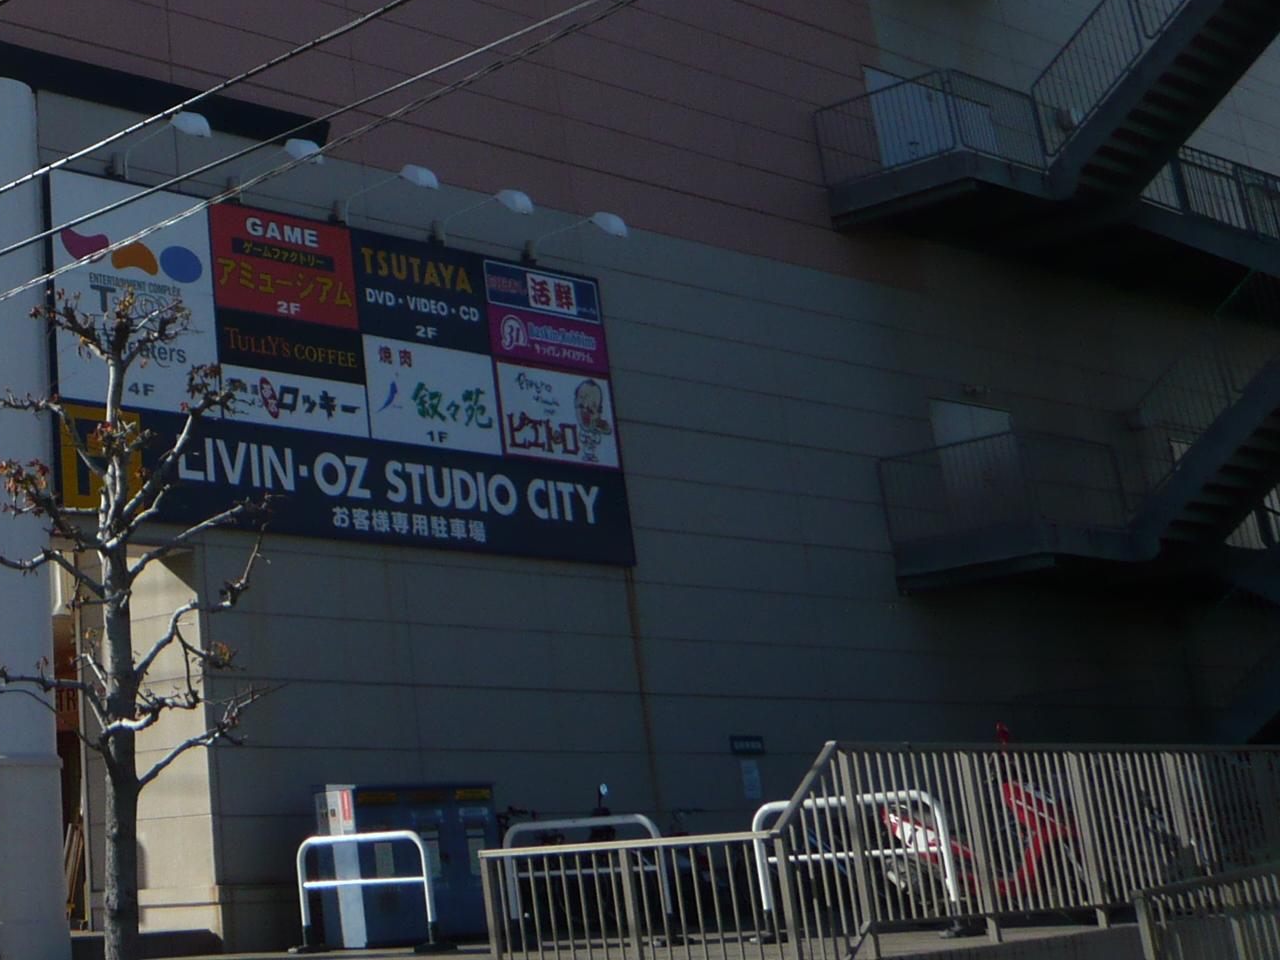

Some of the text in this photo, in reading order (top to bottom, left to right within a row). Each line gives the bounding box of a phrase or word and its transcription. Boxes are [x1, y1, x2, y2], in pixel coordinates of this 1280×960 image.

[245, 217, 320, 248] GAME
[217, 256, 353, 307] アミュージアム
[360, 246, 473, 295] TSUTAYA
[276, 300, 301, 315] 2F
[415, 325, 439, 339] 2F
[294, 344, 358, 369] COFFEE
[128, 382, 155, 396] 4F
[278, 384, 361, 421] ロッキー
[426, 430, 449, 443] 1F
[507, 411, 580, 456] ピエトロ
[385, 459, 518, 517] STUDIO
[527, 478, 600, 525] CITY
[332, 506, 488, 544] お客様専用駐車場
